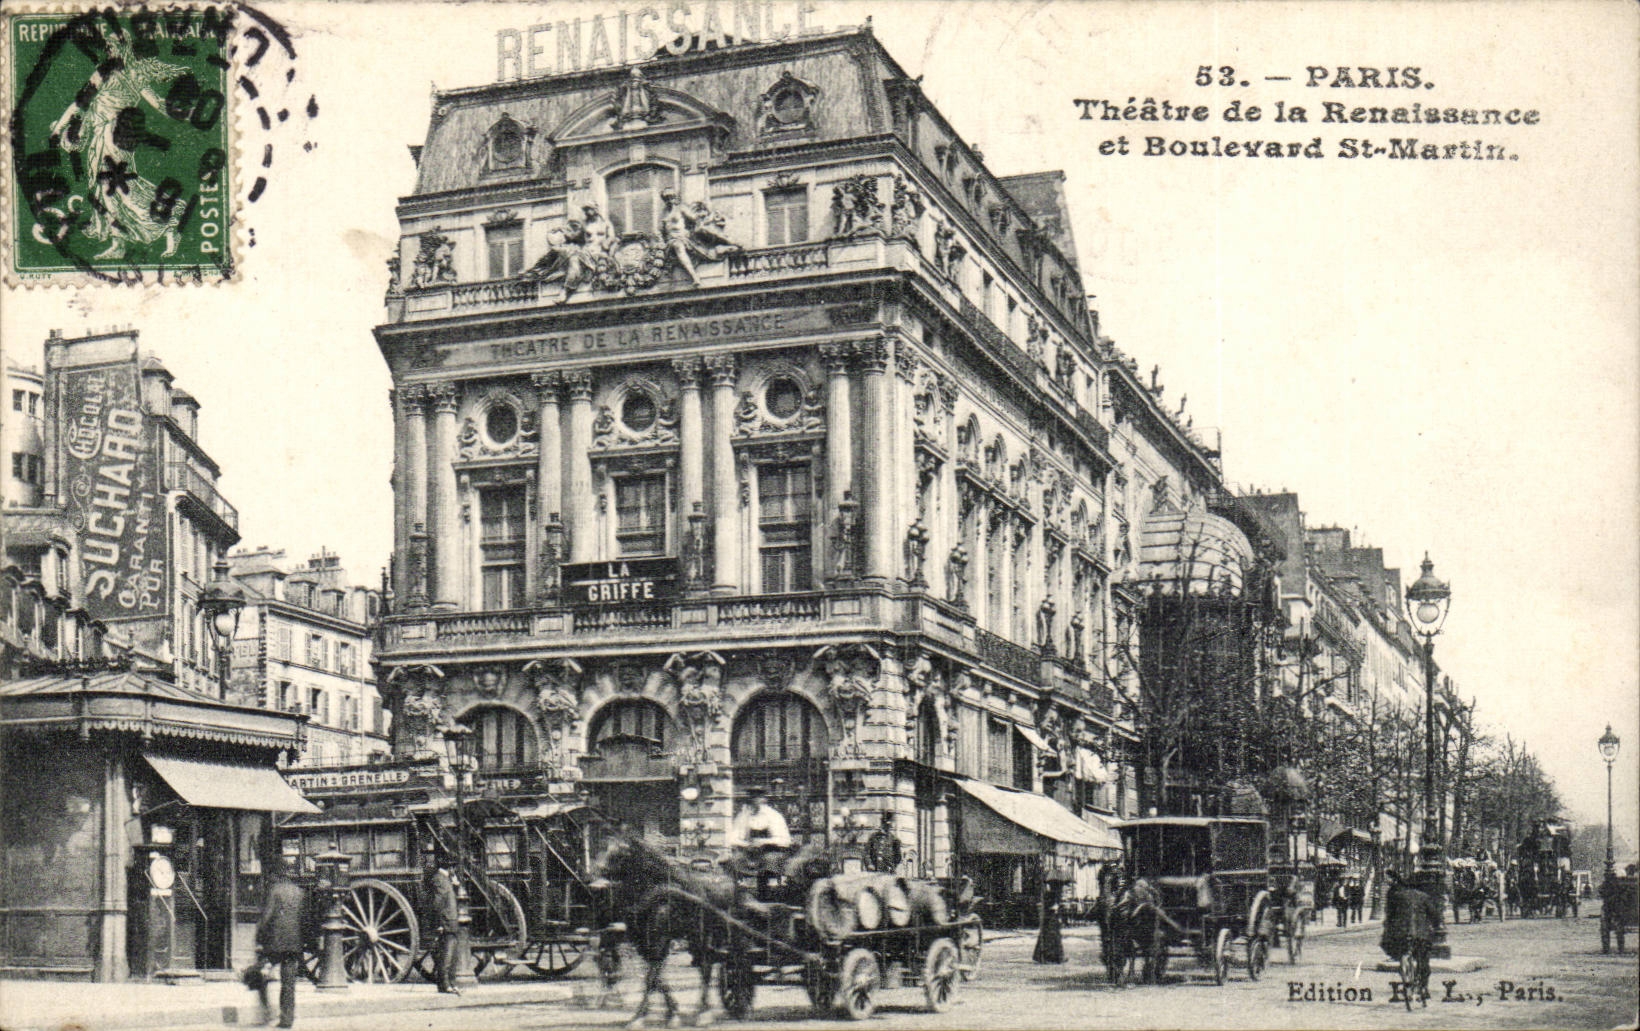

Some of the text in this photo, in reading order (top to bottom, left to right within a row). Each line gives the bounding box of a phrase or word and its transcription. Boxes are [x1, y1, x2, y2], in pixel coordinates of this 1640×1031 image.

[496, 0, 825, 80] RENAISSANCE
[583, 332, 606, 349] DE
[618, 327, 640, 346] LA
[651, 314, 785, 342] RENAISSANCE
[86, 408, 143, 600] SUCHARD
[138, 558, 164, 611] PUR
[588, 581, 654, 601] GRIFFE
[608, 562, 630, 578] LA
